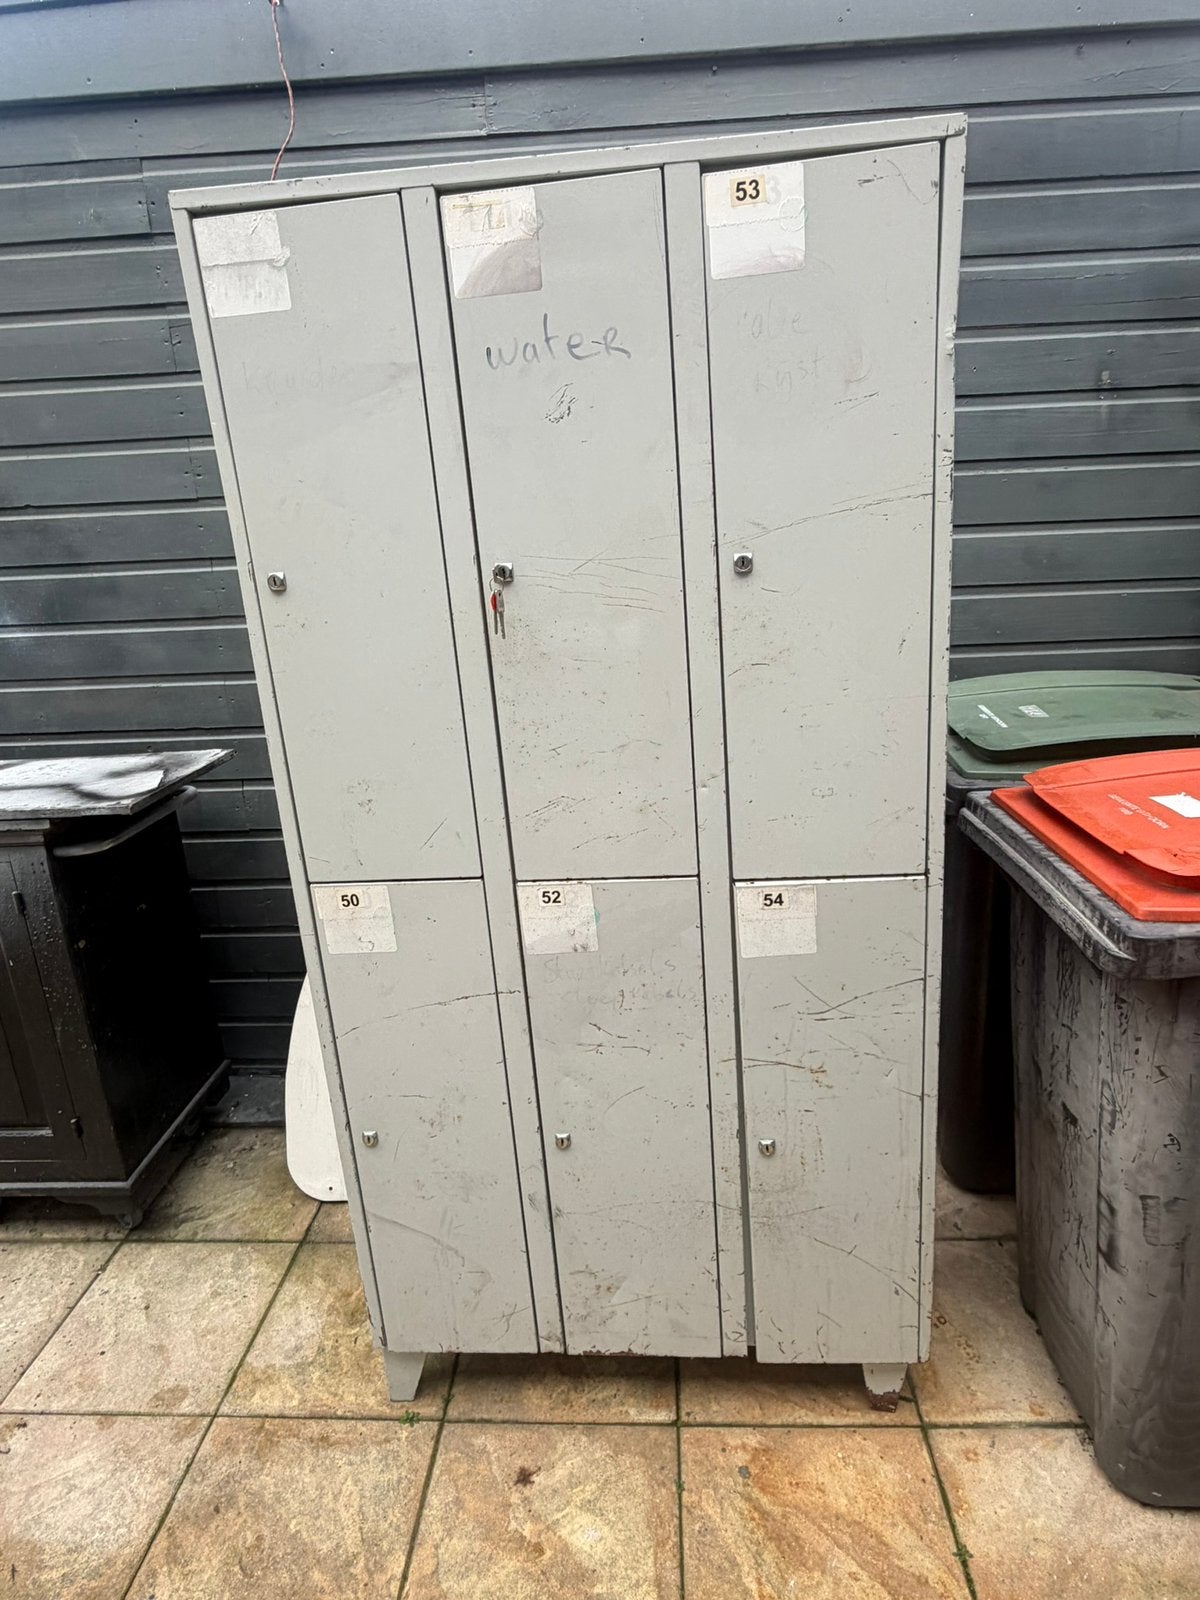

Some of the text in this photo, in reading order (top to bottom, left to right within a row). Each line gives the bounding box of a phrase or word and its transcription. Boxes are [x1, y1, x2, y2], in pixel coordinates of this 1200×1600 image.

[735, 179, 760, 202] 53
[340, 893, 360, 908] 50
[541, 890, 562, 904] 52
[763, 892, 785, 907] 54
